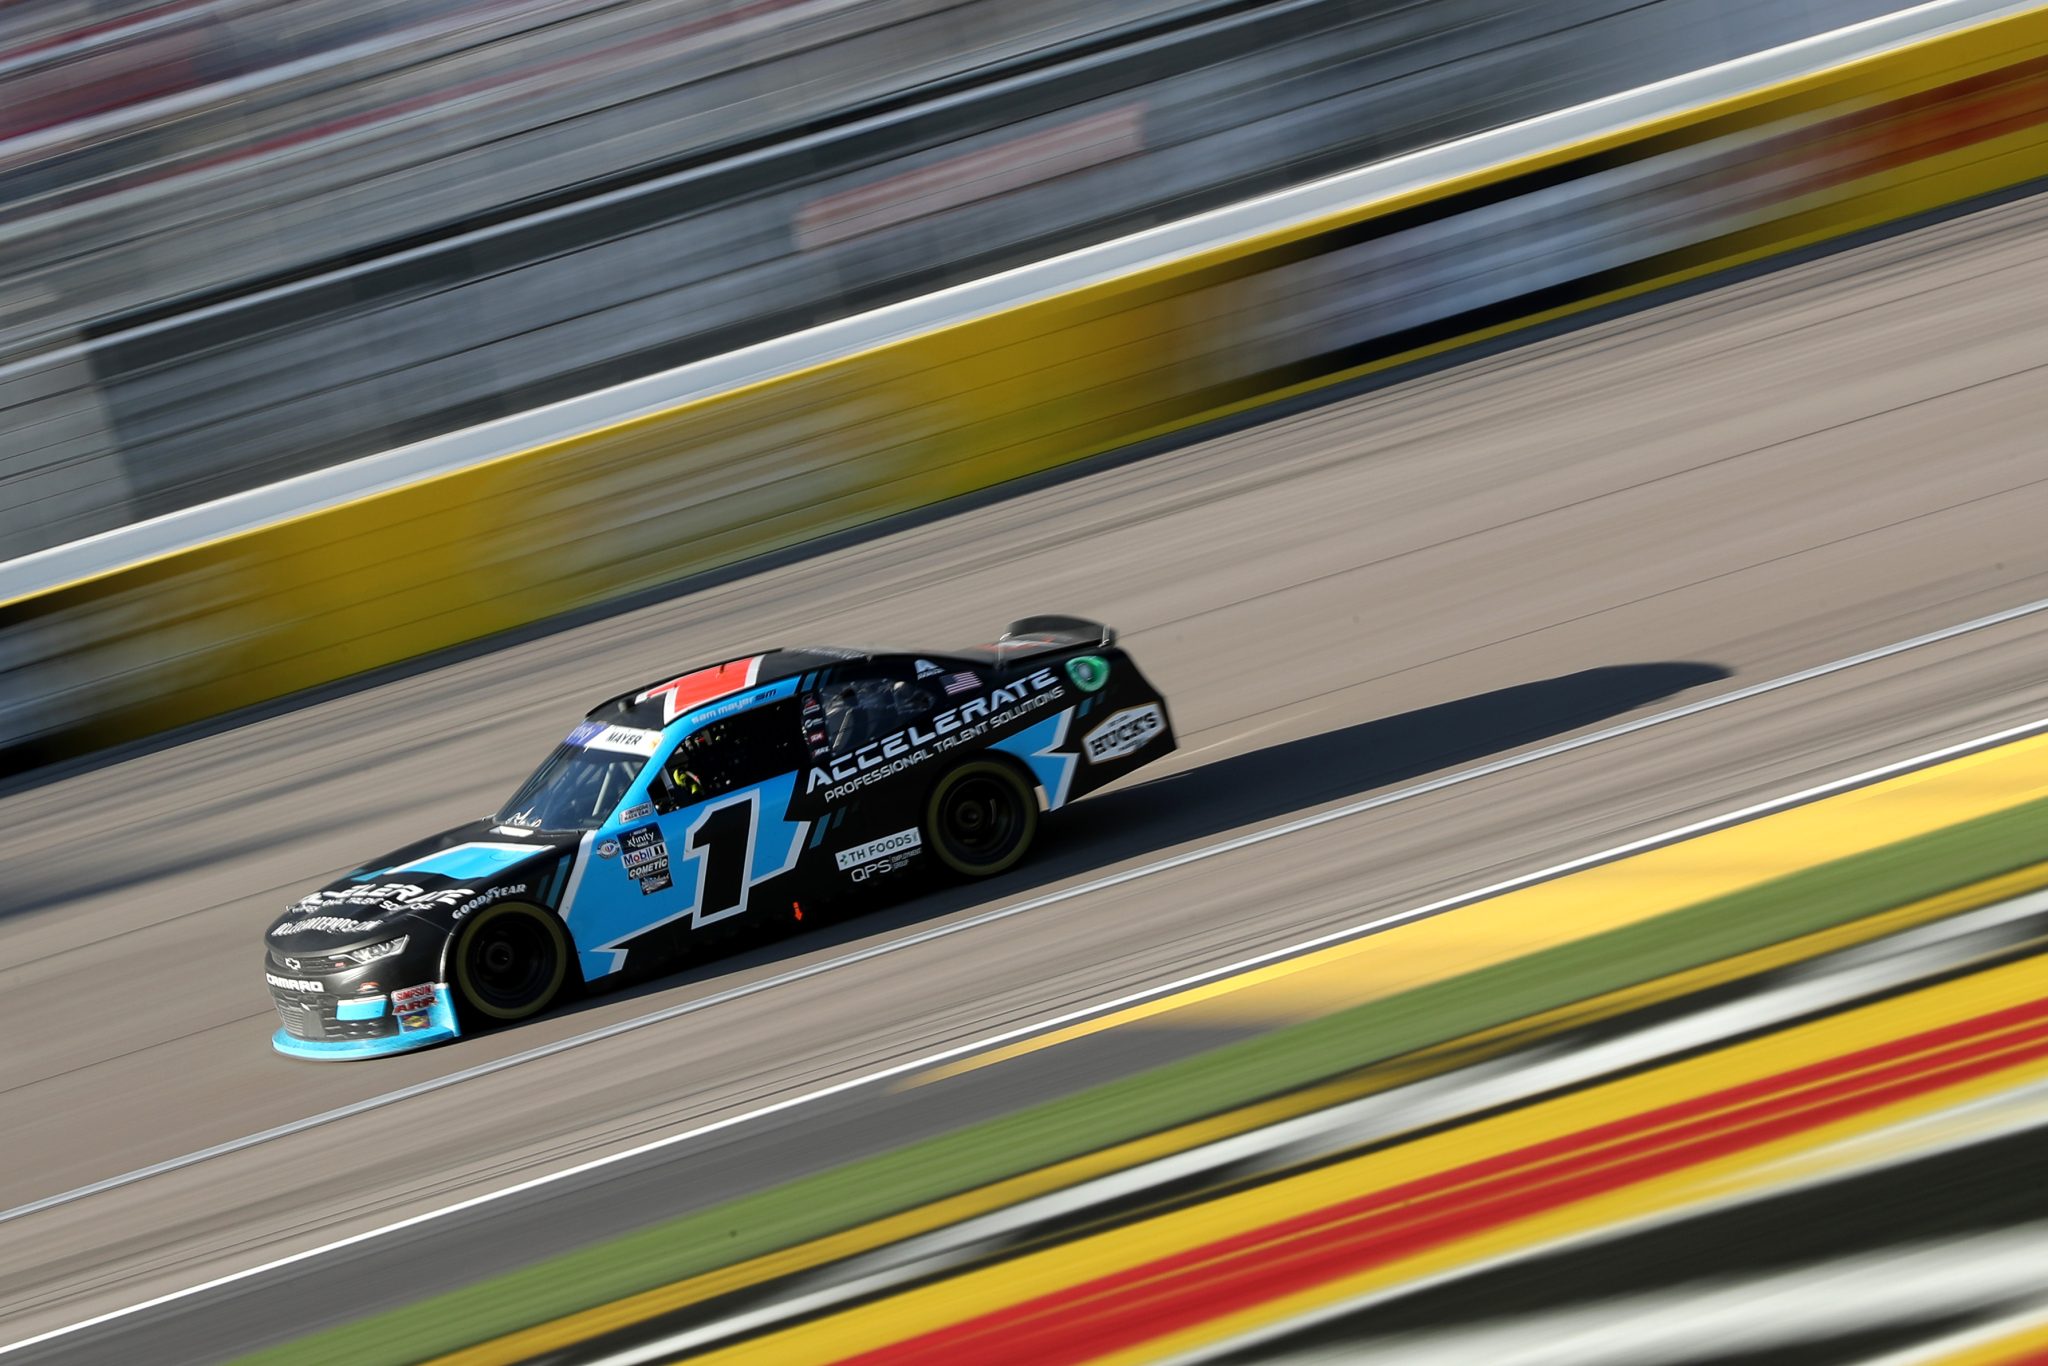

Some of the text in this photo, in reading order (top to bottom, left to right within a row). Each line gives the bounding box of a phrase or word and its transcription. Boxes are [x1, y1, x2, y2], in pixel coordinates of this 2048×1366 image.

[691, 709, 717, 725] sam
[717, 695, 755, 716] mayer
[606, 731, 643, 746] MAYER
[806, 667, 1059, 795] ACCELERATE
[824, 685, 1065, 802] PROFESSIONAL TALENT SOLUTIONS
[627, 831, 654, 848] xfinity
[848, 834, 912, 862] TH FOODS
[623, 847, 653, 866] Mobil
[629, 858, 668, 878] COMETIC
[682, 788, 760, 930] 1
[851, 859, 892, 882] QPS
[452, 883, 527, 920] GOODYEAR
[265, 972, 325, 993] CAMARO
